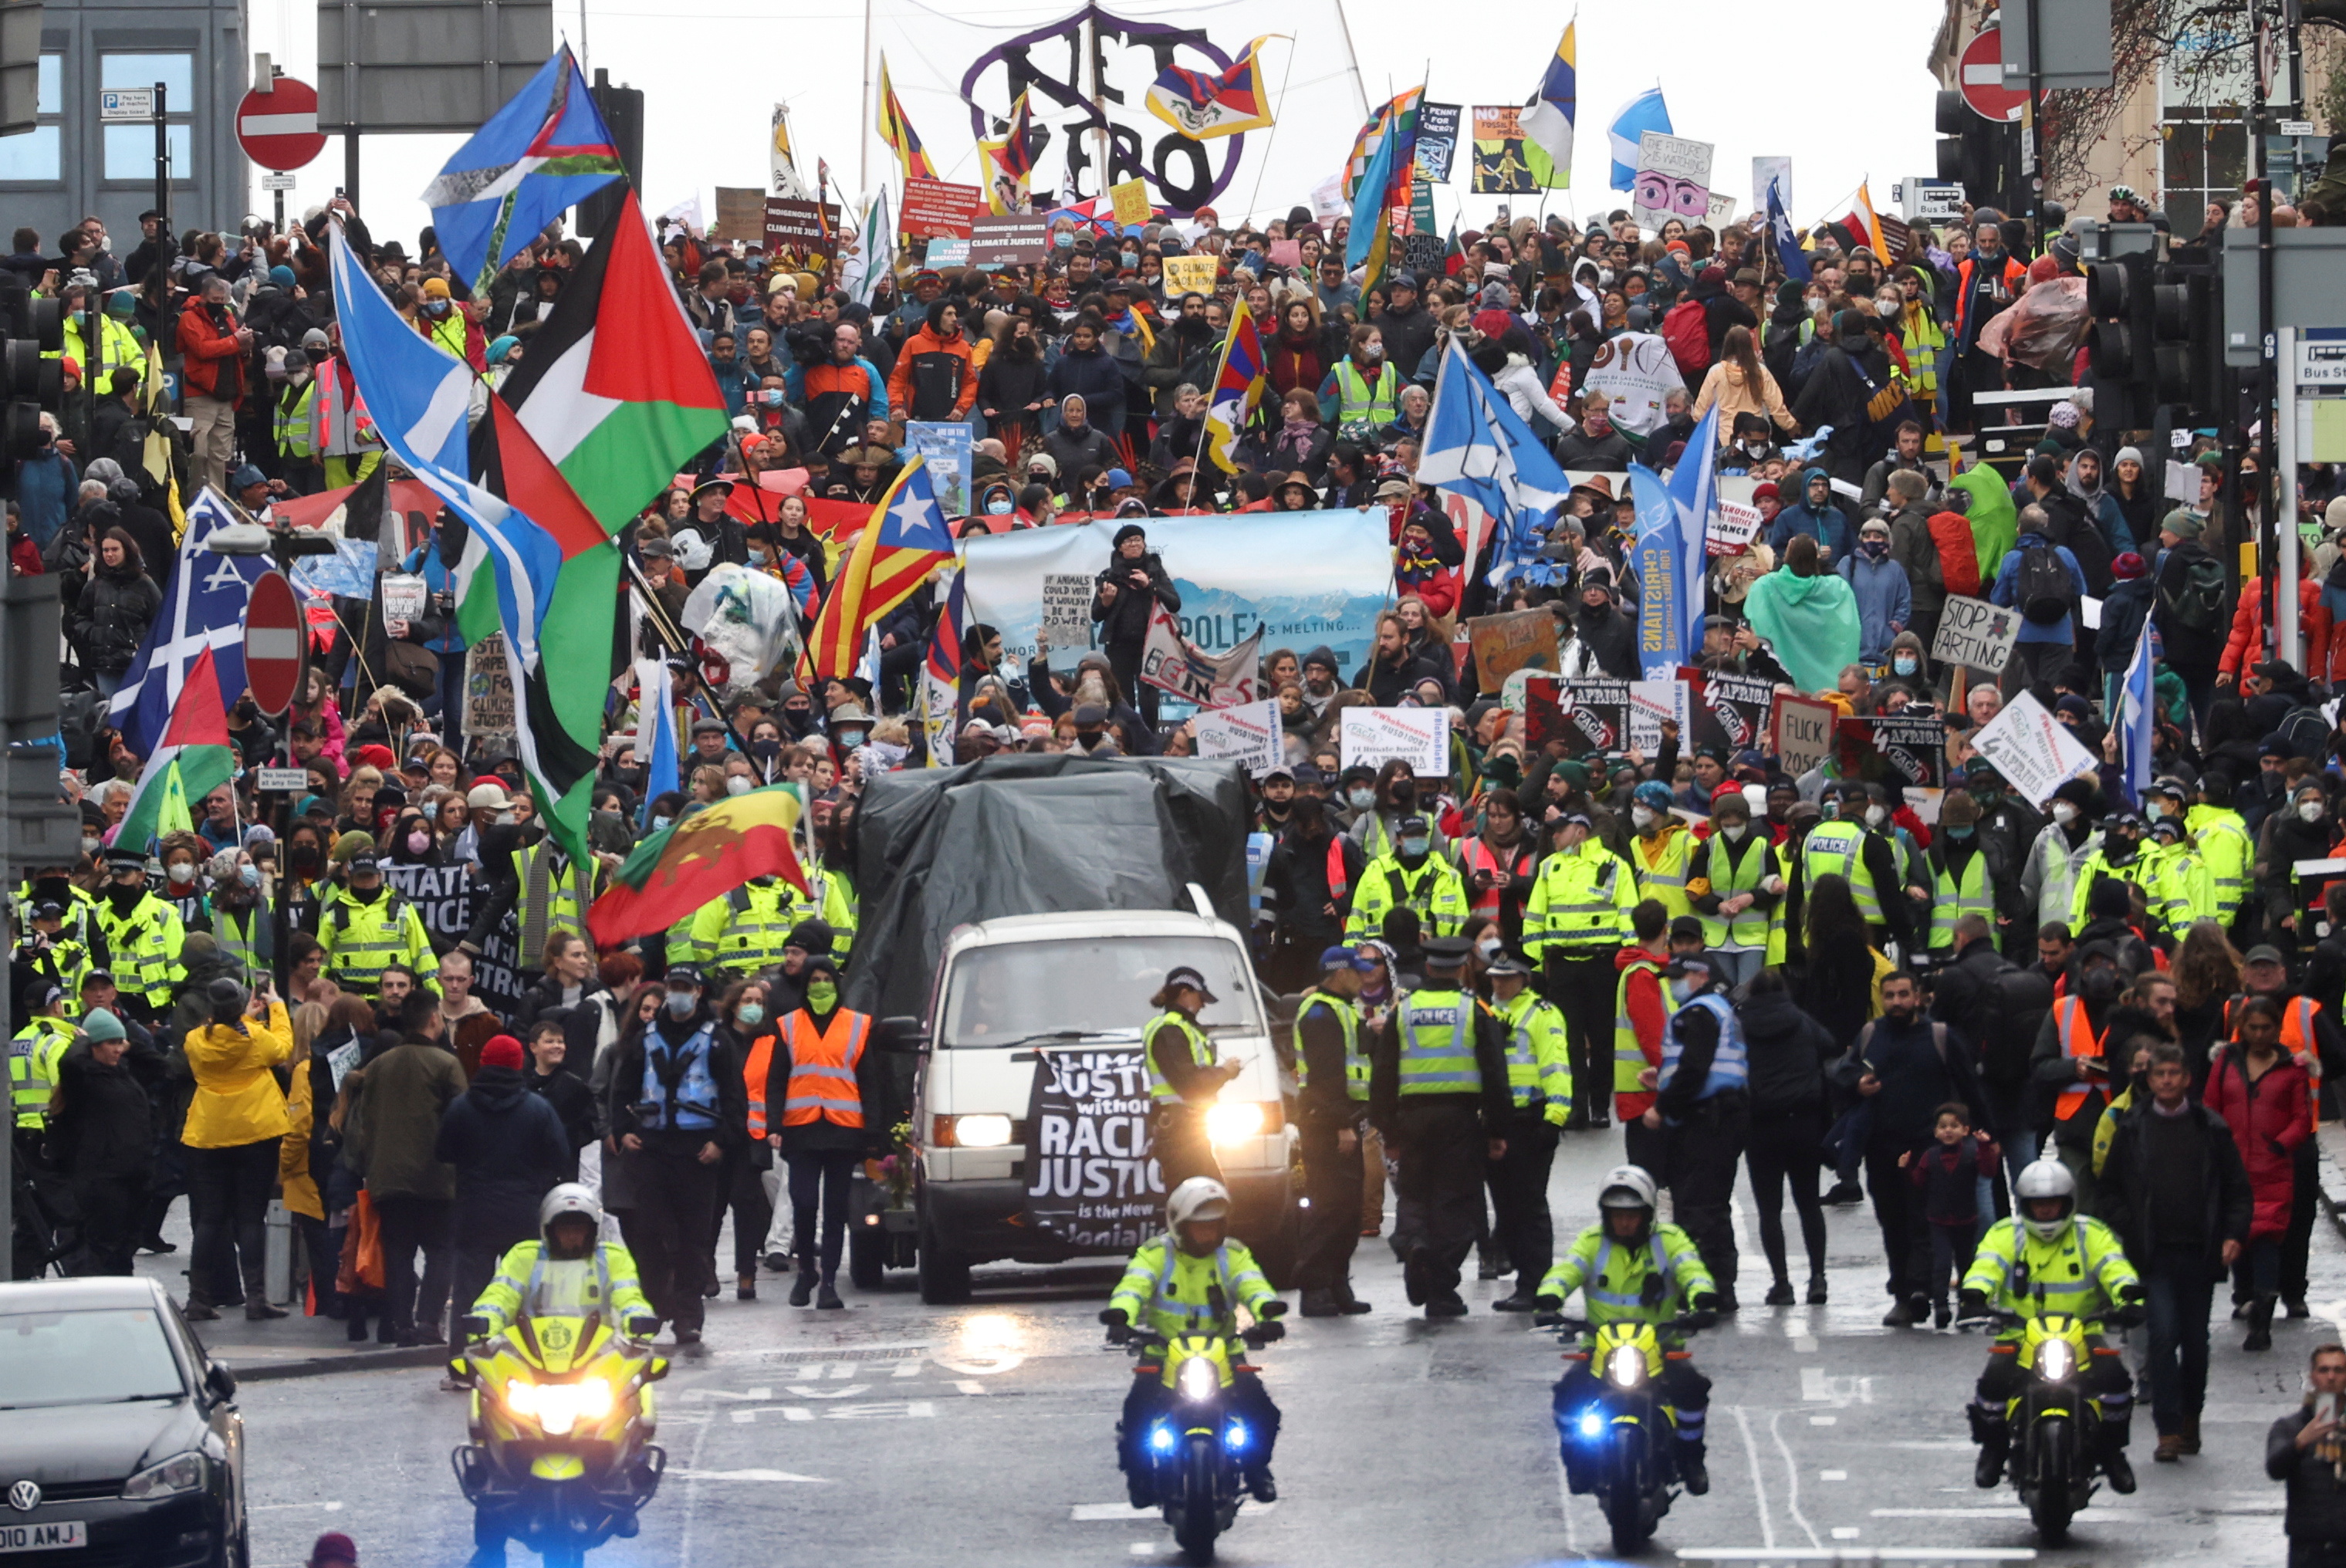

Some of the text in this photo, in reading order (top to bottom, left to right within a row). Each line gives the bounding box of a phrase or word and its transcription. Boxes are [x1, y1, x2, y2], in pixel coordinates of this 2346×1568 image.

[1001, 27, 1208, 117] NET
[1429, 107, 1458, 117] PENNY
[1475, 107, 1499, 120] NO
[1431, 116, 1449, 124] FOR
[1424, 123, 1455, 133] ENERGY
[1647, 138, 1702, 159] THE FUTURE
[992, 115, 1213, 211] ZERO
[1652, 151, 1705, 171] IS WATCHING
[942, 186, 976, 195] INDIGENOUS
[945, 199, 976, 208] HOMELAND
[767, 208, 812, 219] INDIGENOUS
[909, 208, 968, 220] INDIGENOUS PEOPLES
[766, 223, 803, 235] CLIMATE
[973, 224, 1019, 232] INDIGENOUS
[1009, 238, 1045, 246] JUSTICE
[1183, 263, 1215, 272] CLIMATE
[2304, 367, 2329, 379] Bus
[1867, 380, 1905, 423] NIKE
[955, 428, 966, 437] THE
[1727, 515, 1753, 526] JUSTICE
[1046, 576, 1090, 586] IF ANIMALS
[1044, 586, 1090, 596] COULD VOTE
[1043, 596, 1054, 605] WE
[1052, 607, 1063, 616] BE
[1942, 598, 1988, 631] STOP
[1043, 616, 1087, 626] POWER
[1935, 627, 2007, 668] FARTING
[475, 657, 508, 669] PAPE
[1599, 678, 1628, 688] Justice
[1745, 675, 1774, 688] Justice
[1702, 679, 1771, 708] 4 AFRICA
[1557, 686, 1628, 715] 4 AFRICA
[1577, 712, 1606, 743] PACJA
[1720, 706, 1745, 742] PACJA
[1786, 714, 1824, 744] FUCK
[1913, 720, 1943, 728] Justice
[1351, 725, 1377, 740] PACJA
[1871, 728, 1944, 754] 4 AFRICA
[1893, 751, 1925, 779] PACJA
[1982, 737, 2044, 796] 4 AFRICA
[1810, 838, 1847, 853] POLICE
[1411, 1009, 1455, 1025] POLICE
[1029, 1157, 1166, 1198] JUSTIC
[1078, 1203, 1154, 1218] is the New
[34, 1523, 74, 1546] AMJ
